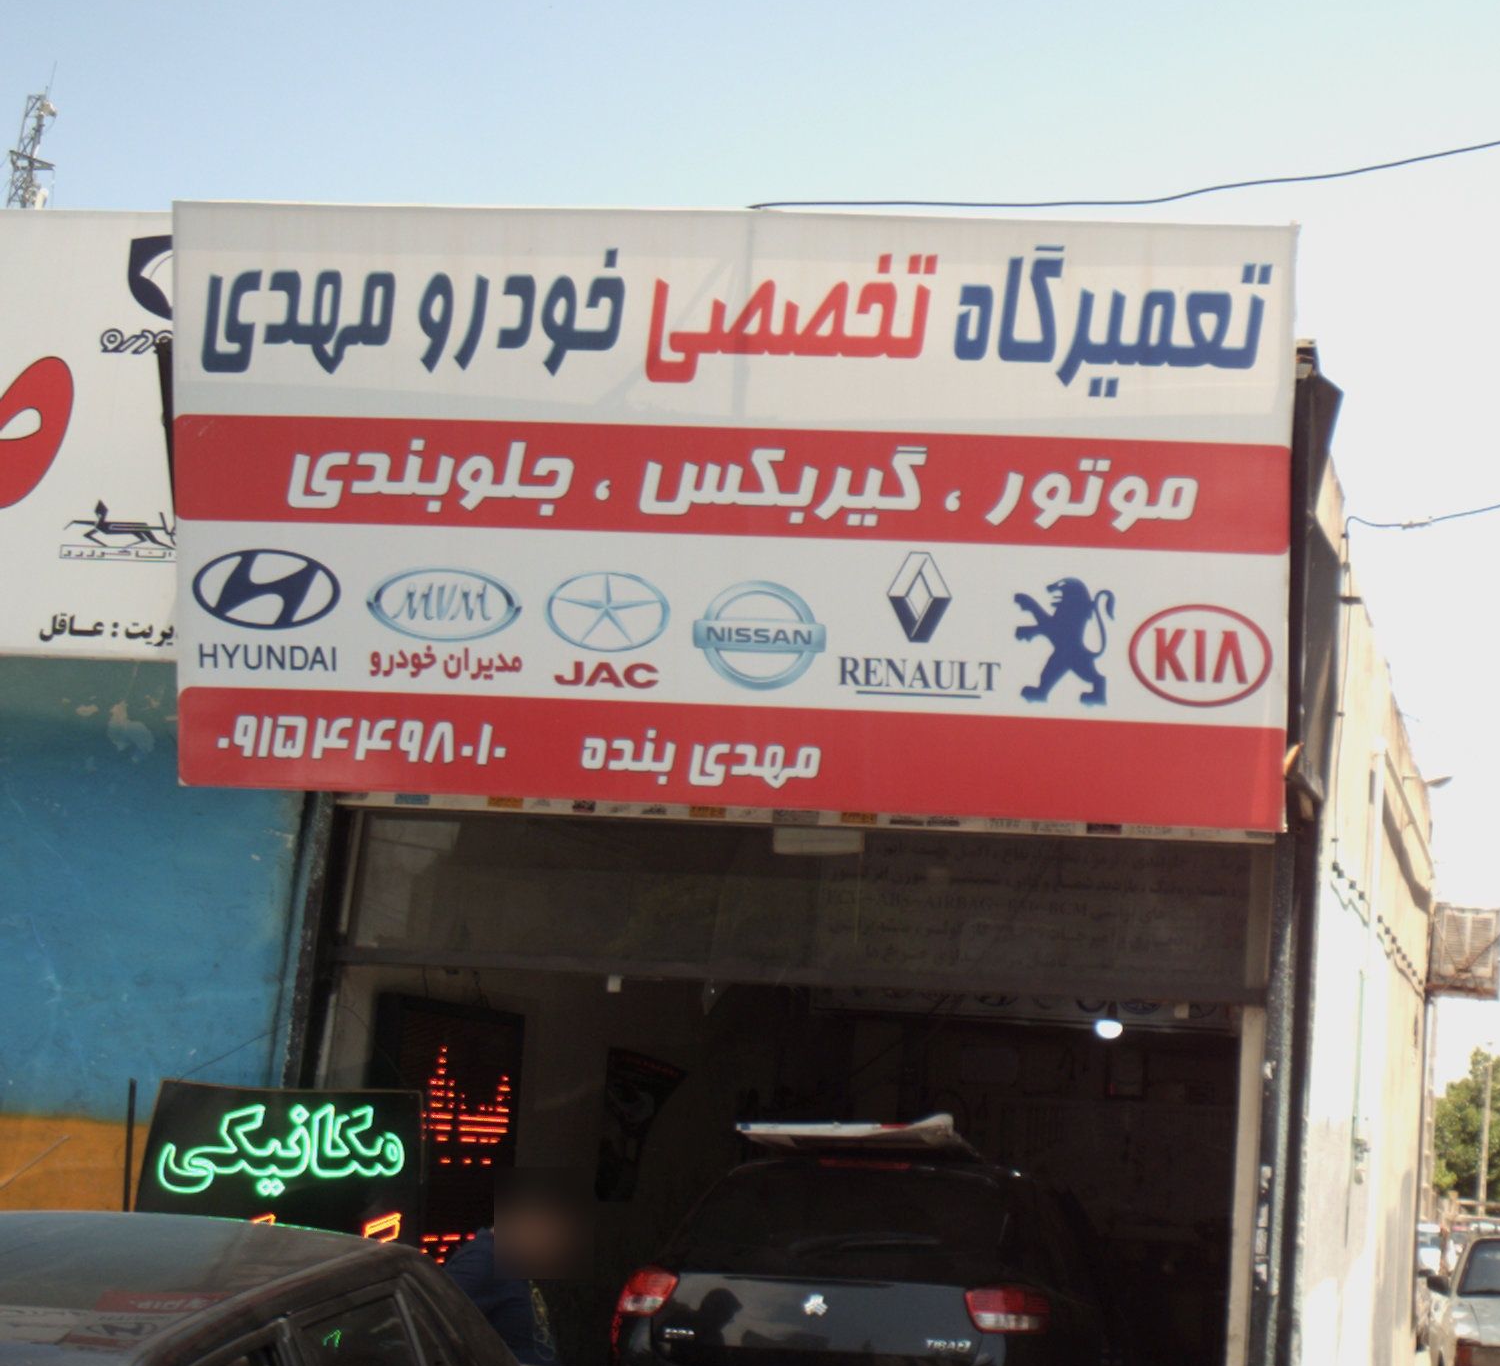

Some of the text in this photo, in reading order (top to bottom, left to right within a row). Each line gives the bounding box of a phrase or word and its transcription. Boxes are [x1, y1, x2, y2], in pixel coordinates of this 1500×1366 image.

[200, 246, 1272, 398] تعمیرگاه تخصصی خودرو مهدی
[286, 438, 575, 516] جلوبندی
[638, 445, 928, 527] گیربکس
[984, 457, 1199, 533] موتور
[198, 643, 337, 672] HYUNDAI
[370, 645, 524, 681] مدیران خودرو
[706, 626, 813, 646] NISSAN
[1154, 626, 1249, 686] KIA
[554, 660, 659, 689] JAC
[838, 656, 1000, 692] RENAULT
[217, 715, 506, 765] ۰۹۱۵۴۴۹۸۰۱۰
[581, 729, 821, 789] مهدی بنده
[157, 1102, 405, 1197] مکانیکی
